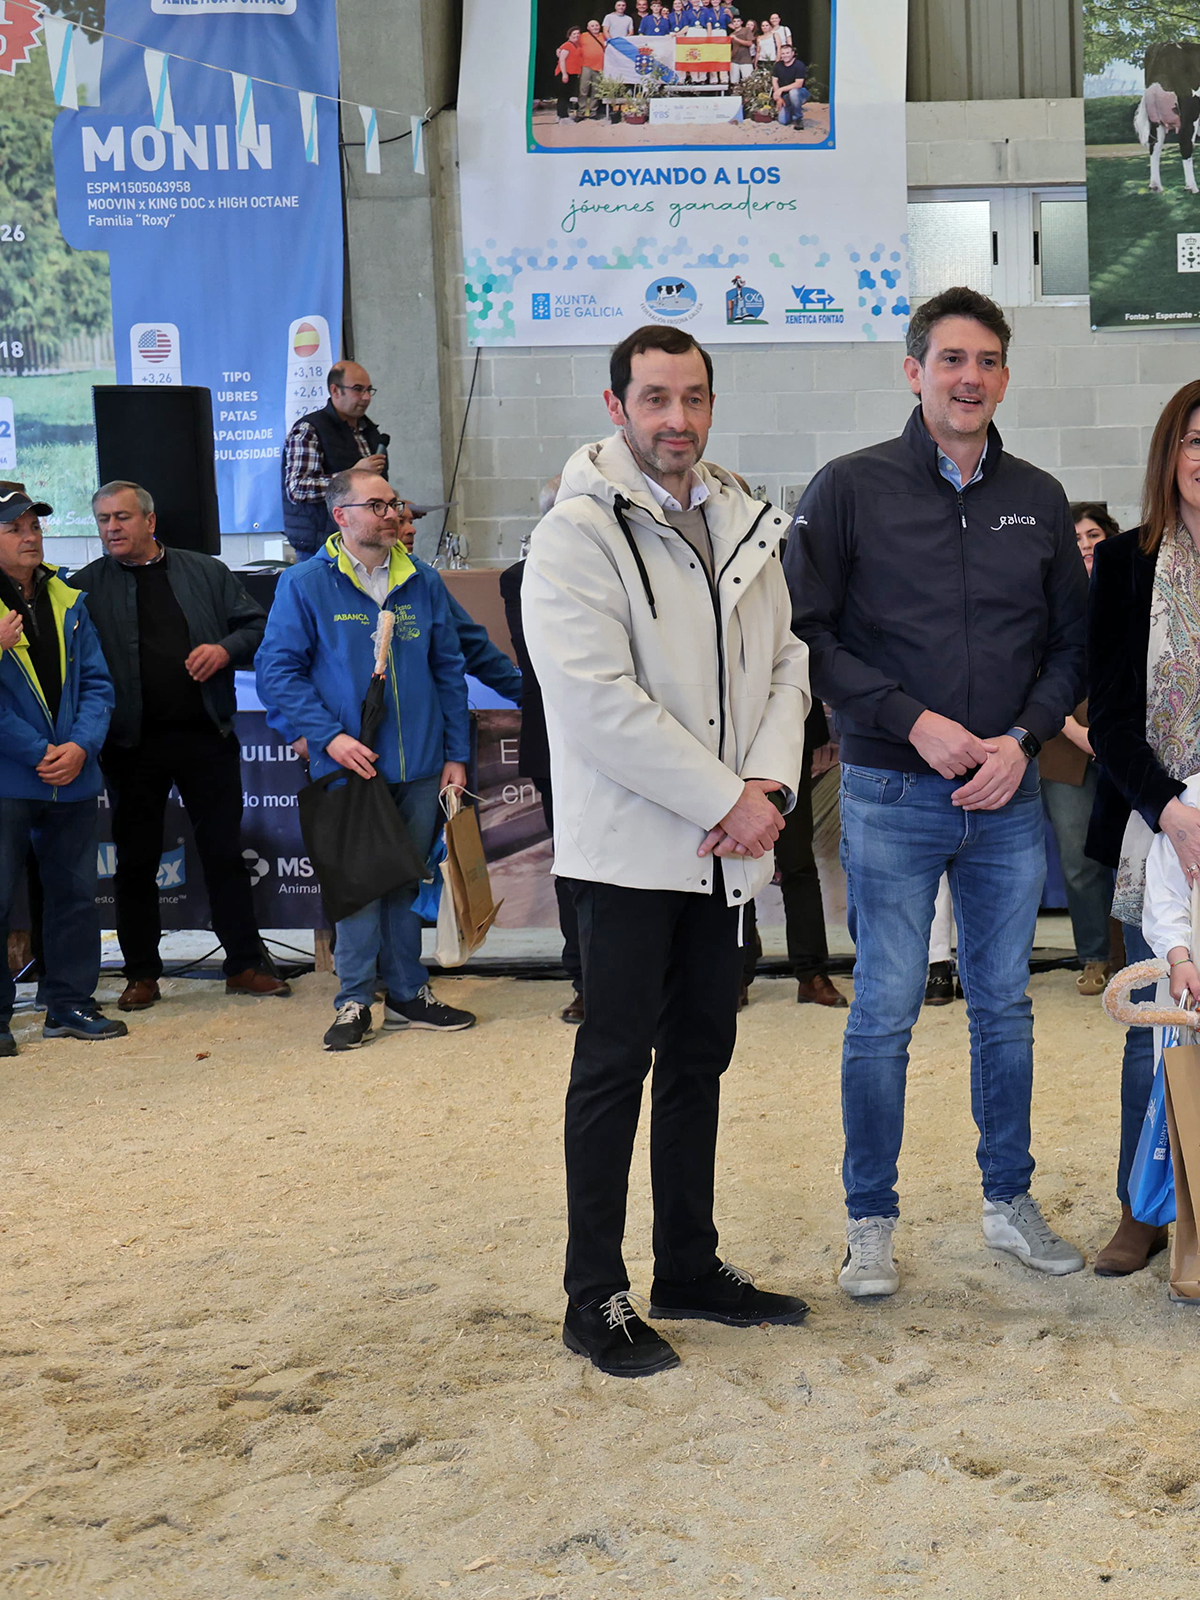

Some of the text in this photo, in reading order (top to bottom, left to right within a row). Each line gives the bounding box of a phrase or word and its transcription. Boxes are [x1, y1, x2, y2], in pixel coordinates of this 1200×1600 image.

[81, 123, 273, 172] MONIN
[579, 166, 781, 187] APOYANDO A LOS
[86, 181, 191, 194] ESPM1505063958
[88, 195, 299, 210] MOOVIN x KING DOC x HIGH OCTANE
[561, 184, 797, 233] jóvenes ganaderos
[88, 214, 133, 227] Familia
[0, 224, 25, 242] 26
[554, 294, 597, 305] XUNTA
[554, 306, 624, 318] DE GALICIA
[1125, 313, 1150, 321] Fontao
[1155, 312, 1193, 320] Esperante
[818, 314, 845, 324] FONTAO
[141, 372, 173, 385] +3,26
[222, 371, 251, 383] TIPO
[293, 366, 323, 378] +3,18
[217, 390, 258, 402] UBRES
[293, 386, 324, 398] +2,61
[220, 410, 258, 422] PATAS
[213, 428, 273, 441] APACIDADE
[214, 447, 281, 461] GULOSIDADE
[65, 511, 96, 526] Santo
[990, 513, 1036, 531] galicia
[336, 613, 369, 621] ABANCA
[242, 745, 300, 762] UILID
[277, 857, 314, 878] MS
[278, 882, 321, 894] Animal
